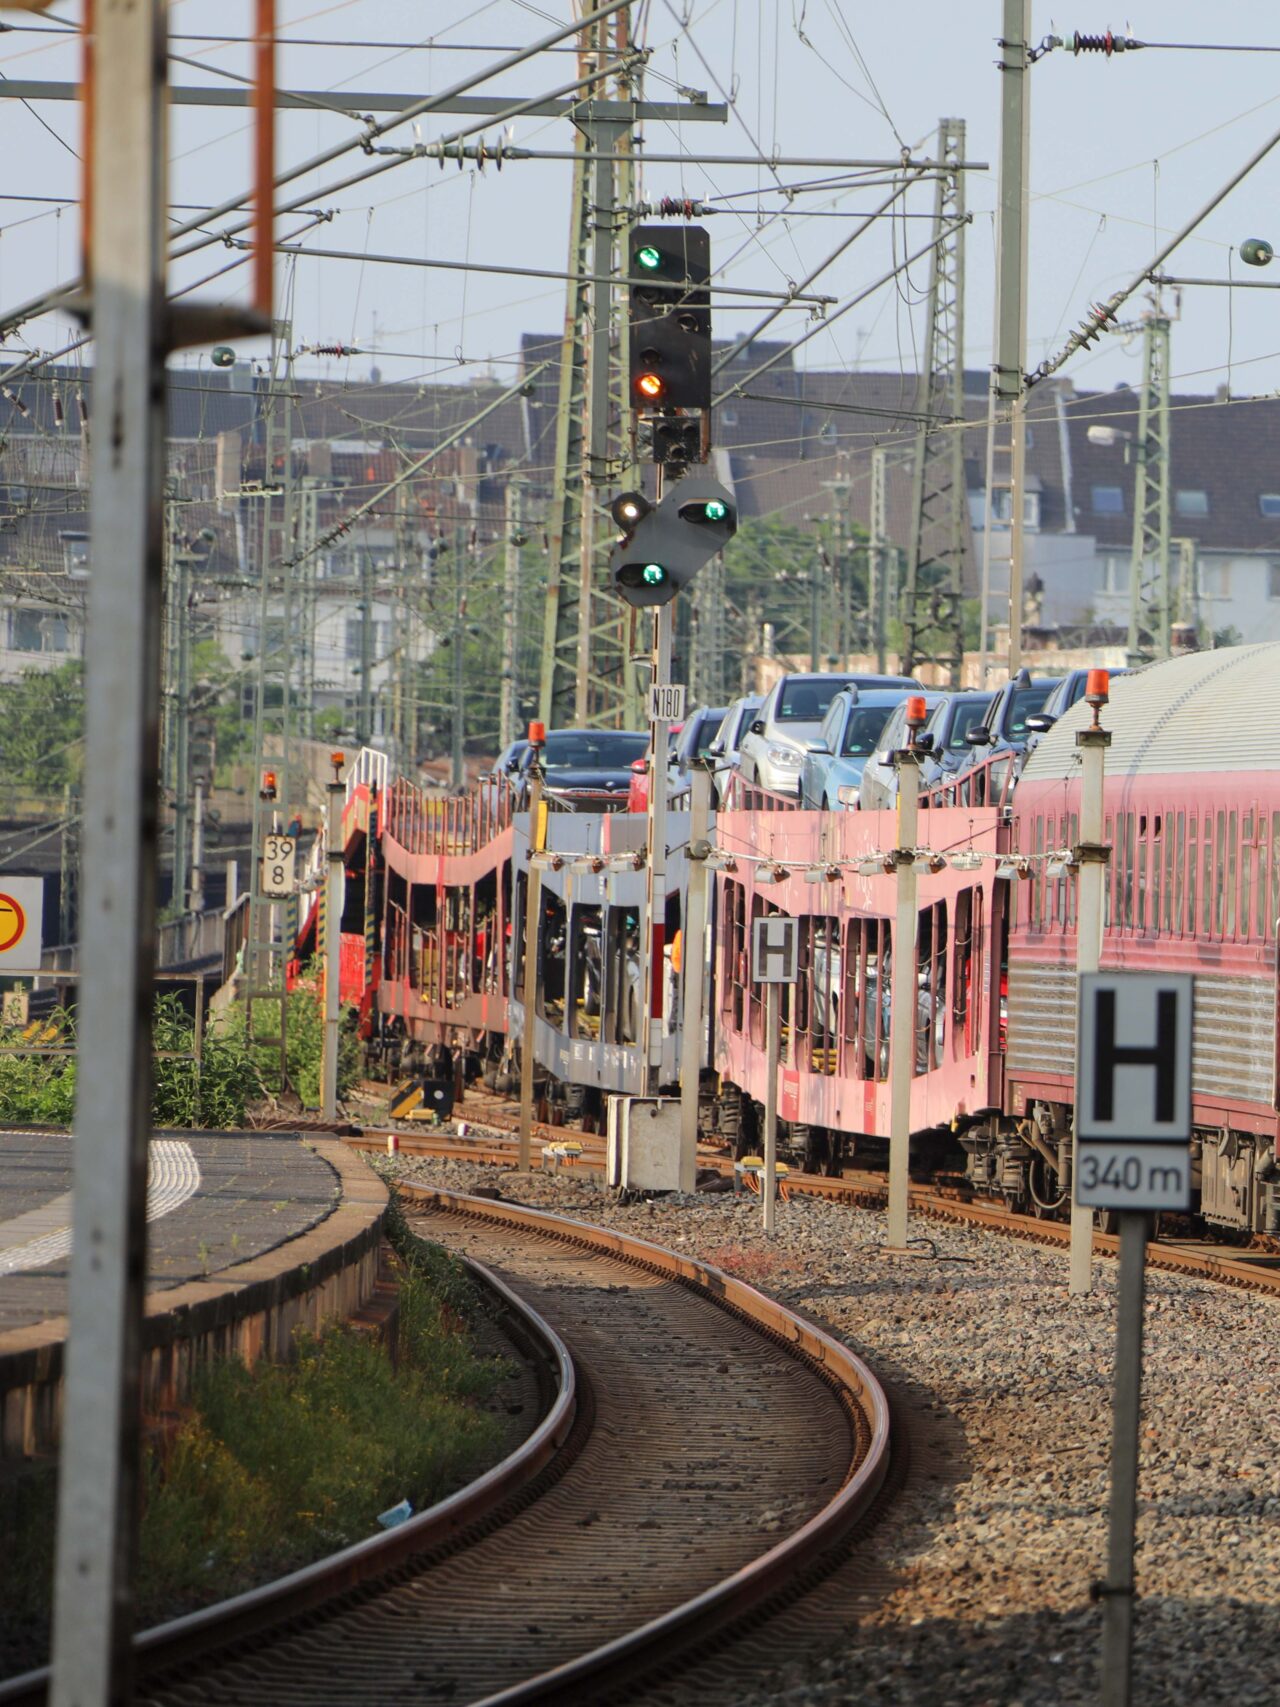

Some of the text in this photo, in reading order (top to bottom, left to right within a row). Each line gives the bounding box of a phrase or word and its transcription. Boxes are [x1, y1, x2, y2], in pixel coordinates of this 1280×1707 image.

[653, 688, 680, 718] N180
[266, 840, 294, 861] 39
[272, 865, 285, 885] 8
[759, 922, 793, 977] H
[1093, 988, 1178, 1123] H
[1081, 1154, 1183, 1193] 340 m
